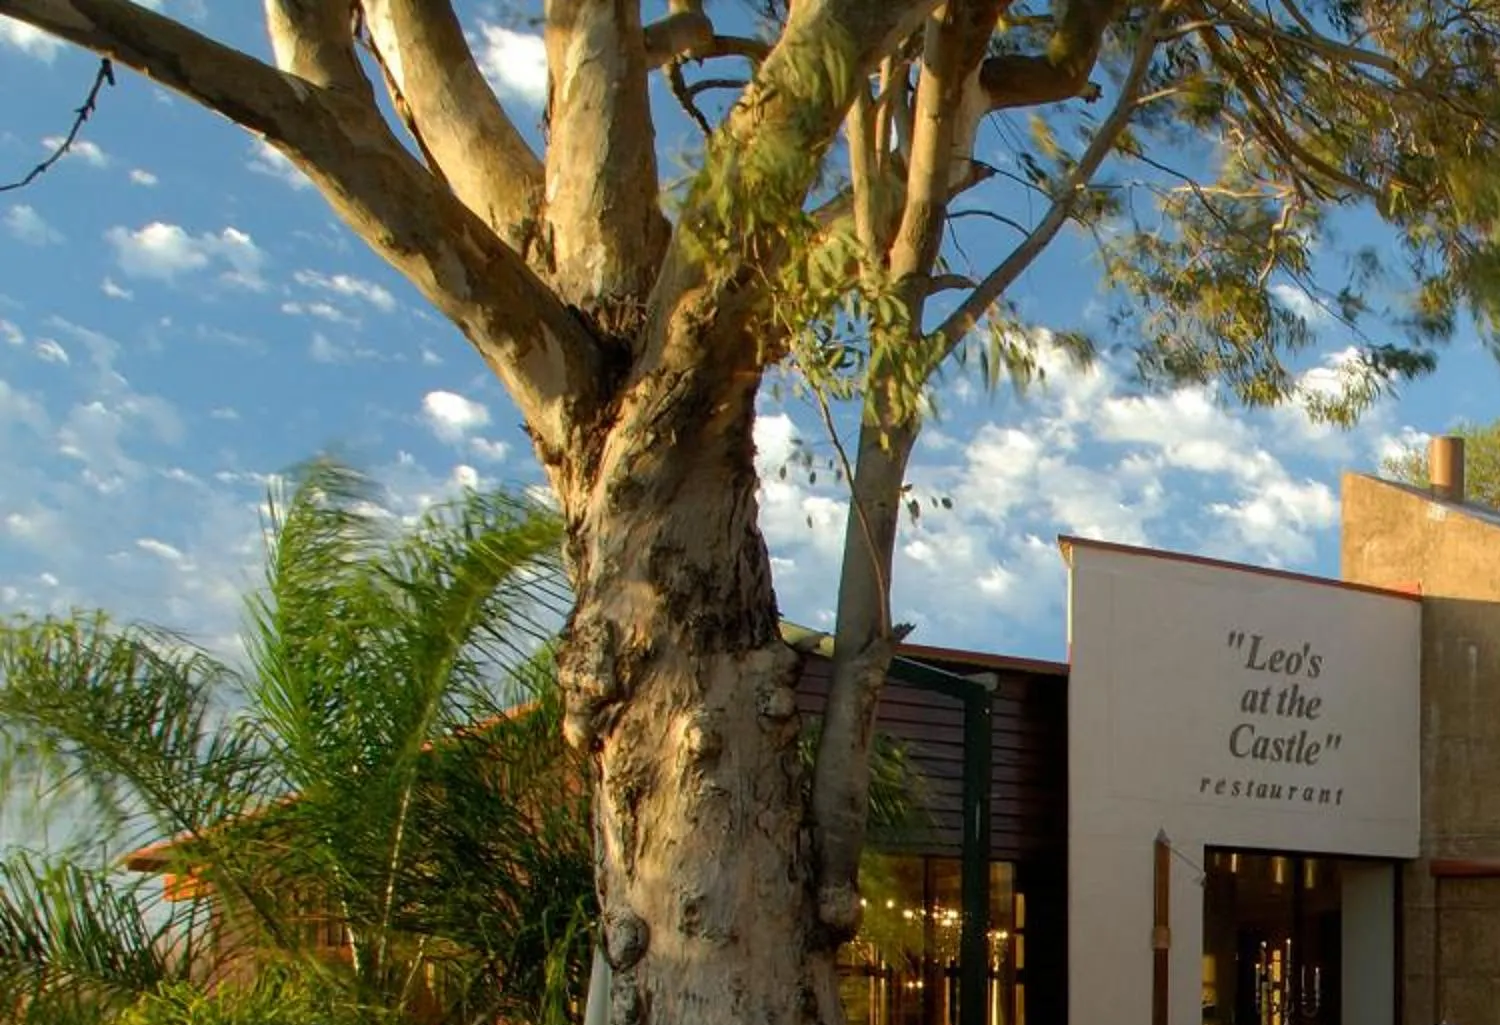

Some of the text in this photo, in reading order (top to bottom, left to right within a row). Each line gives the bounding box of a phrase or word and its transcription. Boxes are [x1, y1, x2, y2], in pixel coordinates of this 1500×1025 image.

[1228, 631, 1323, 678] "Leo's
[1240, 684, 1322, 720] at the
[1229, 723, 1342, 765] Castle"
[1200, 777, 1343, 805] restaurant
